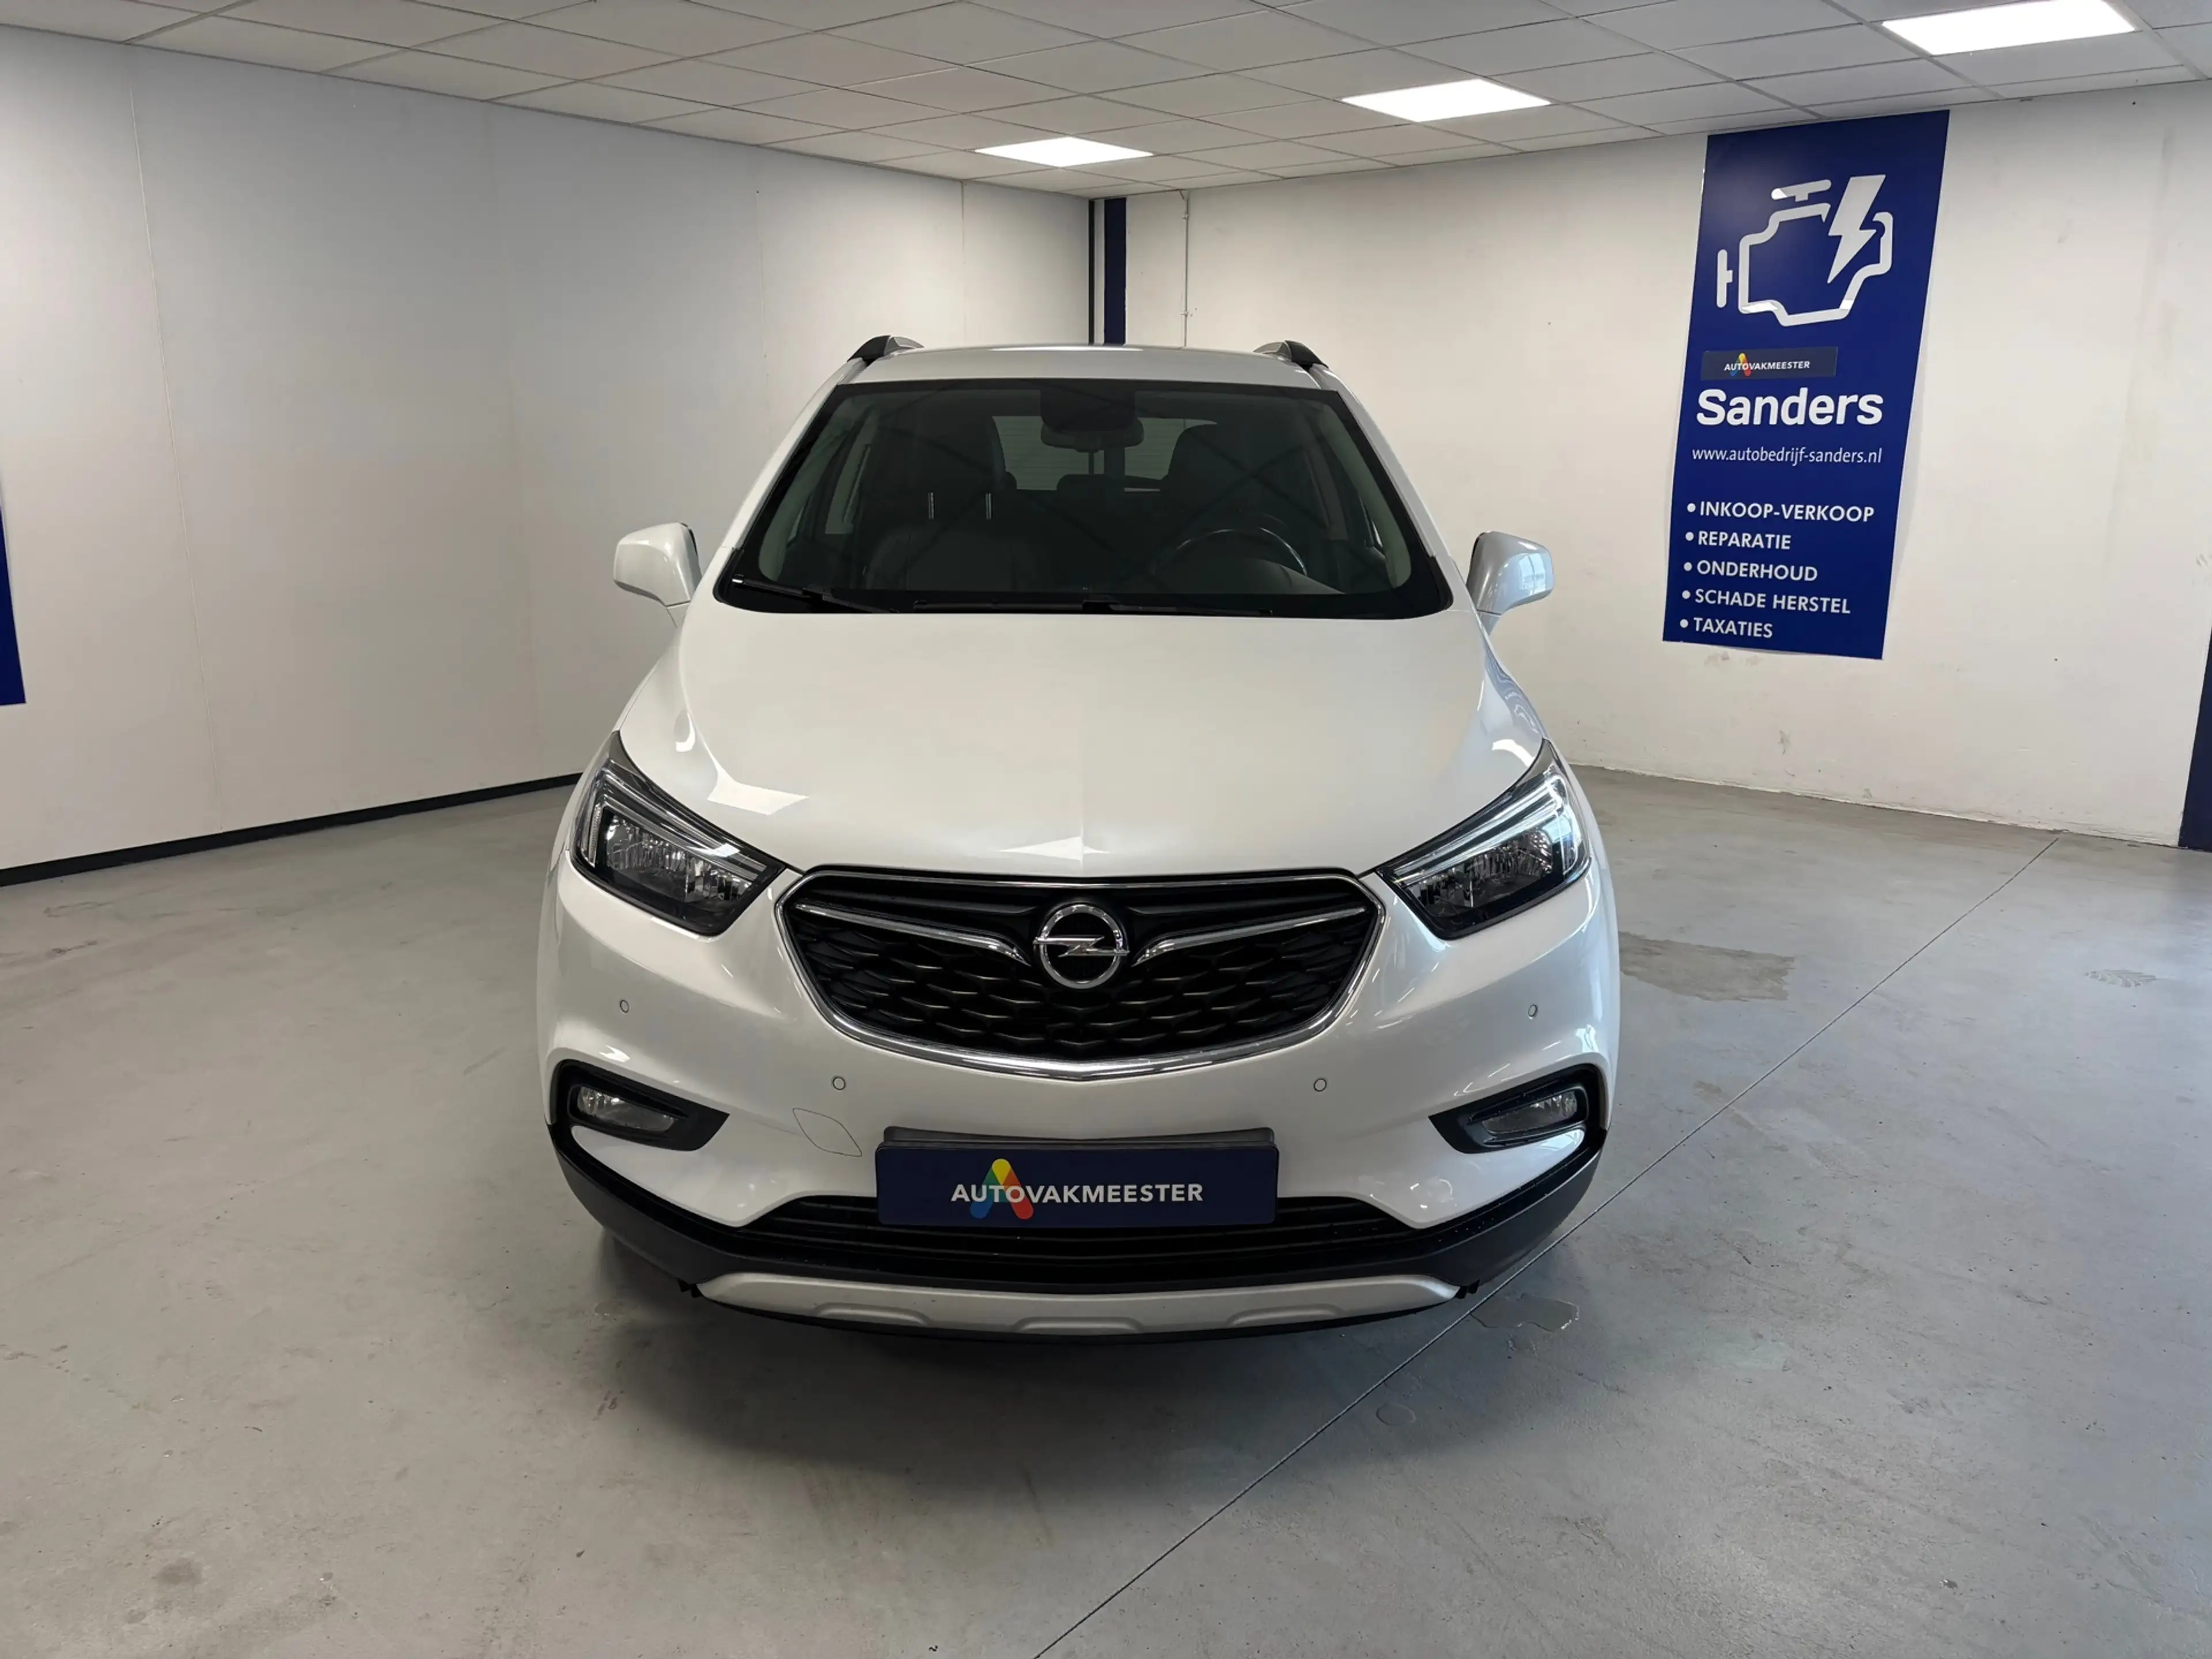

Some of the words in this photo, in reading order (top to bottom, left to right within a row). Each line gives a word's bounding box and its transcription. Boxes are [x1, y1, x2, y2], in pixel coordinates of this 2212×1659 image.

[1724, 361, 1810, 371] AUTOVAKMEESTER
[1696, 387, 1884, 426] Sanders
[1692, 446, 1882, 467] www.autobedrijf-sanders.nl
[1700, 501, 1874, 522] INKOOP-VERKOOP
[1698, 531, 1791, 550] REPARATIE
[1697, 560, 1817, 581] ONDERHOUD
[1695, 589, 1766, 608] SCHADE
[1773, 594, 1850, 613] HERSTEL
[1694, 617, 1772, 638] TAXATIES
[951, 1184, 1202, 1203] AUTOVAKMEESTER
